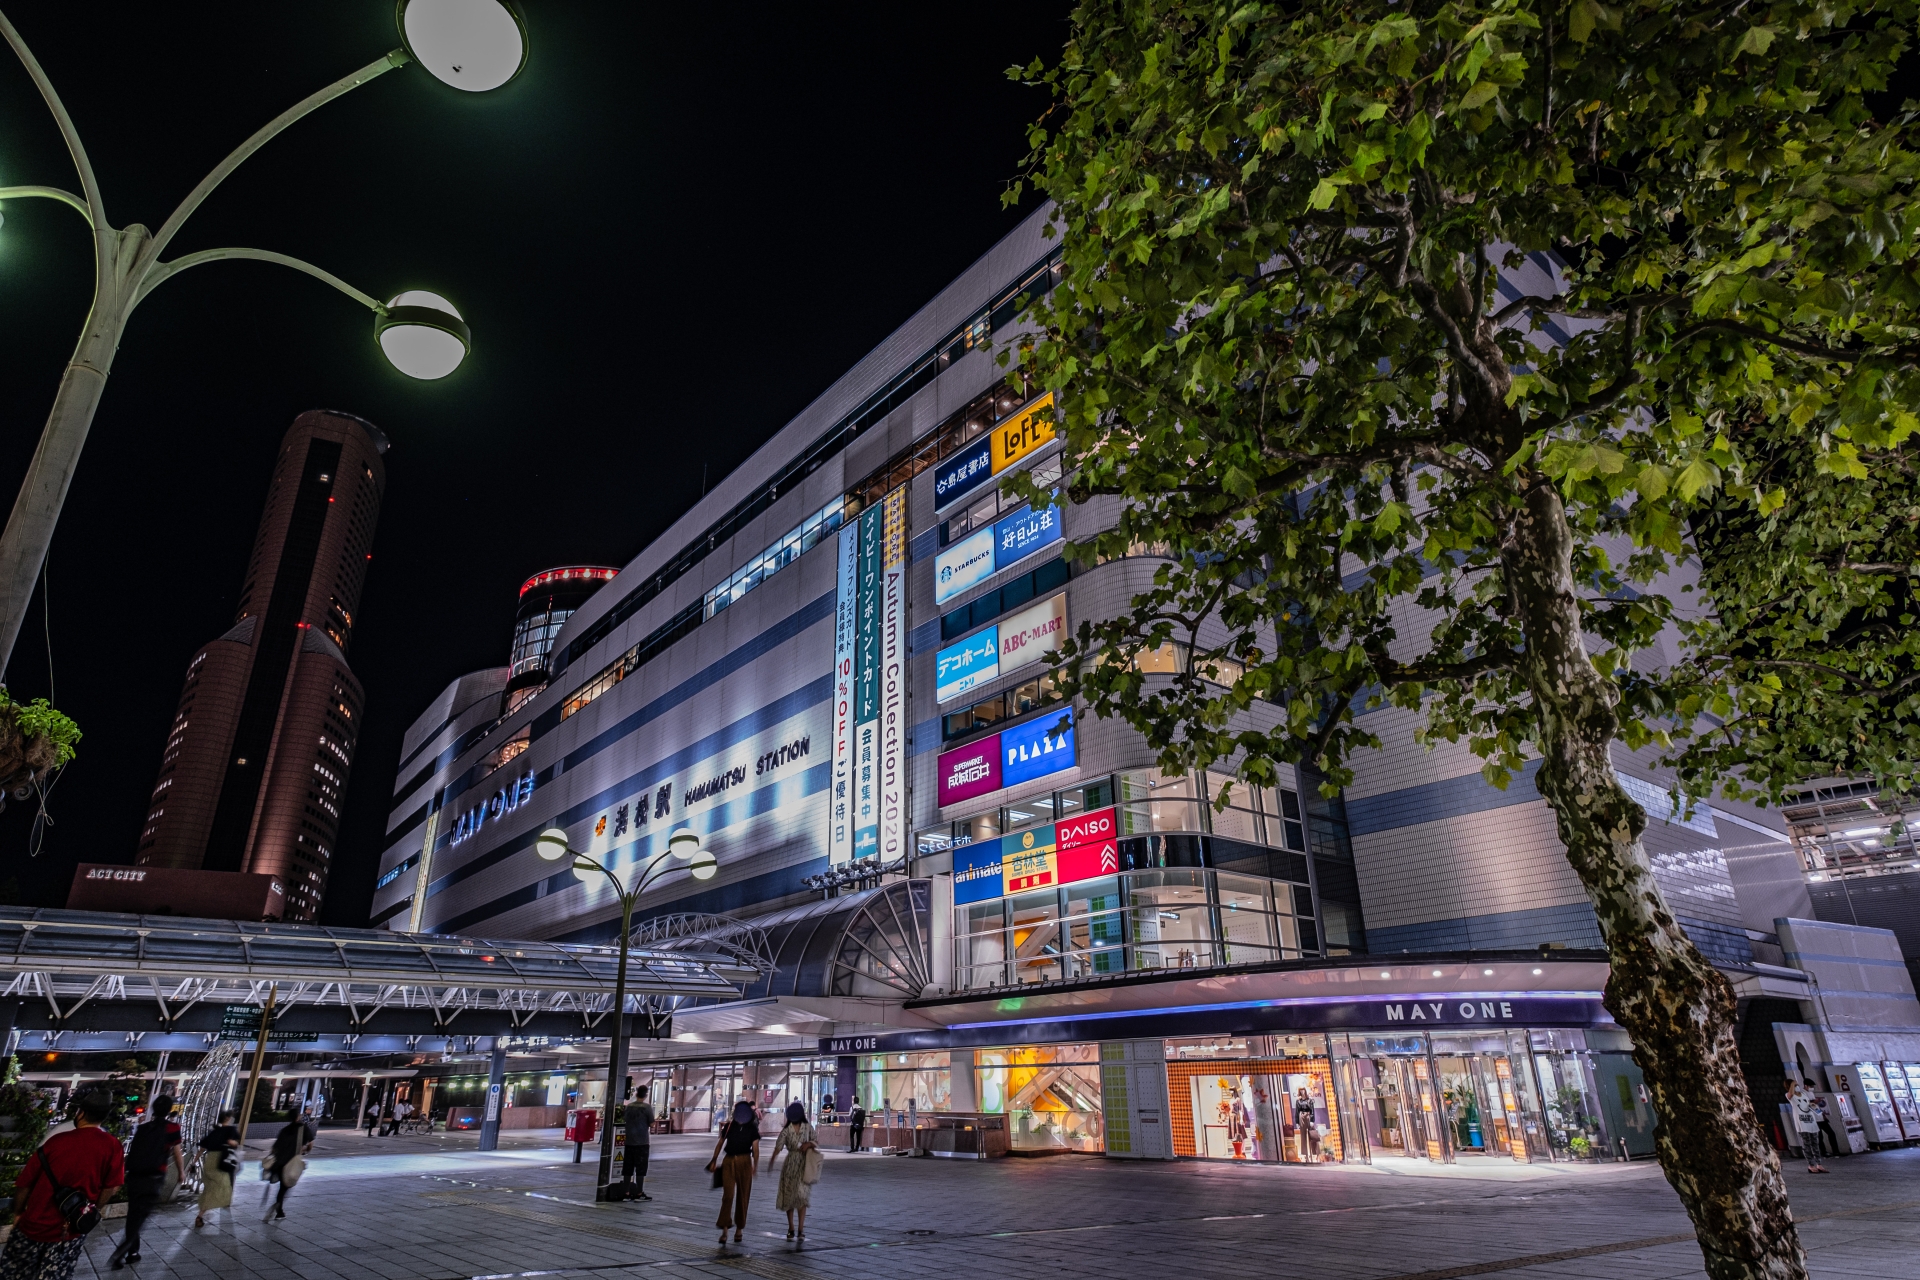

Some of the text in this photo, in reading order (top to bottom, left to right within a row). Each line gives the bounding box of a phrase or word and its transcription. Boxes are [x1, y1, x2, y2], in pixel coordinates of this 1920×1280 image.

[937, 451, 990, 495] 谷島屋書店
[1002, 510, 1054, 551] 好日山荘
[954, 549, 990, 574] STARBUCKS
[1003, 616, 1062, 655] ABC-MART
[938, 638, 996, 679] デコホーム
[959, 676, 975, 691] ニトリ
[885, 572, 900, 853] Autumn Collection 2020
[1008, 733, 1067, 766] PLAZA
[684, 735, 811, 808] HAMAMATSU STATION
[861, 728, 872, 820] 会員募集中
[948, 762, 990, 789] 成城石井
[953, 755, 983, 772] SUPERMARKET
[489, 769, 534, 821] ONE
[1061, 818, 1110, 842] DAISO
[1061, 840, 1082, 850] ダイソー
[955, 861, 1003, 884] animate
[1012, 849, 1047, 872] 杏林堂
[86, 868, 147, 881] ACT CITY
[1385, 1002, 1513, 1020] MAY ONE
[831, 1037, 877, 1051] MAY ONE
